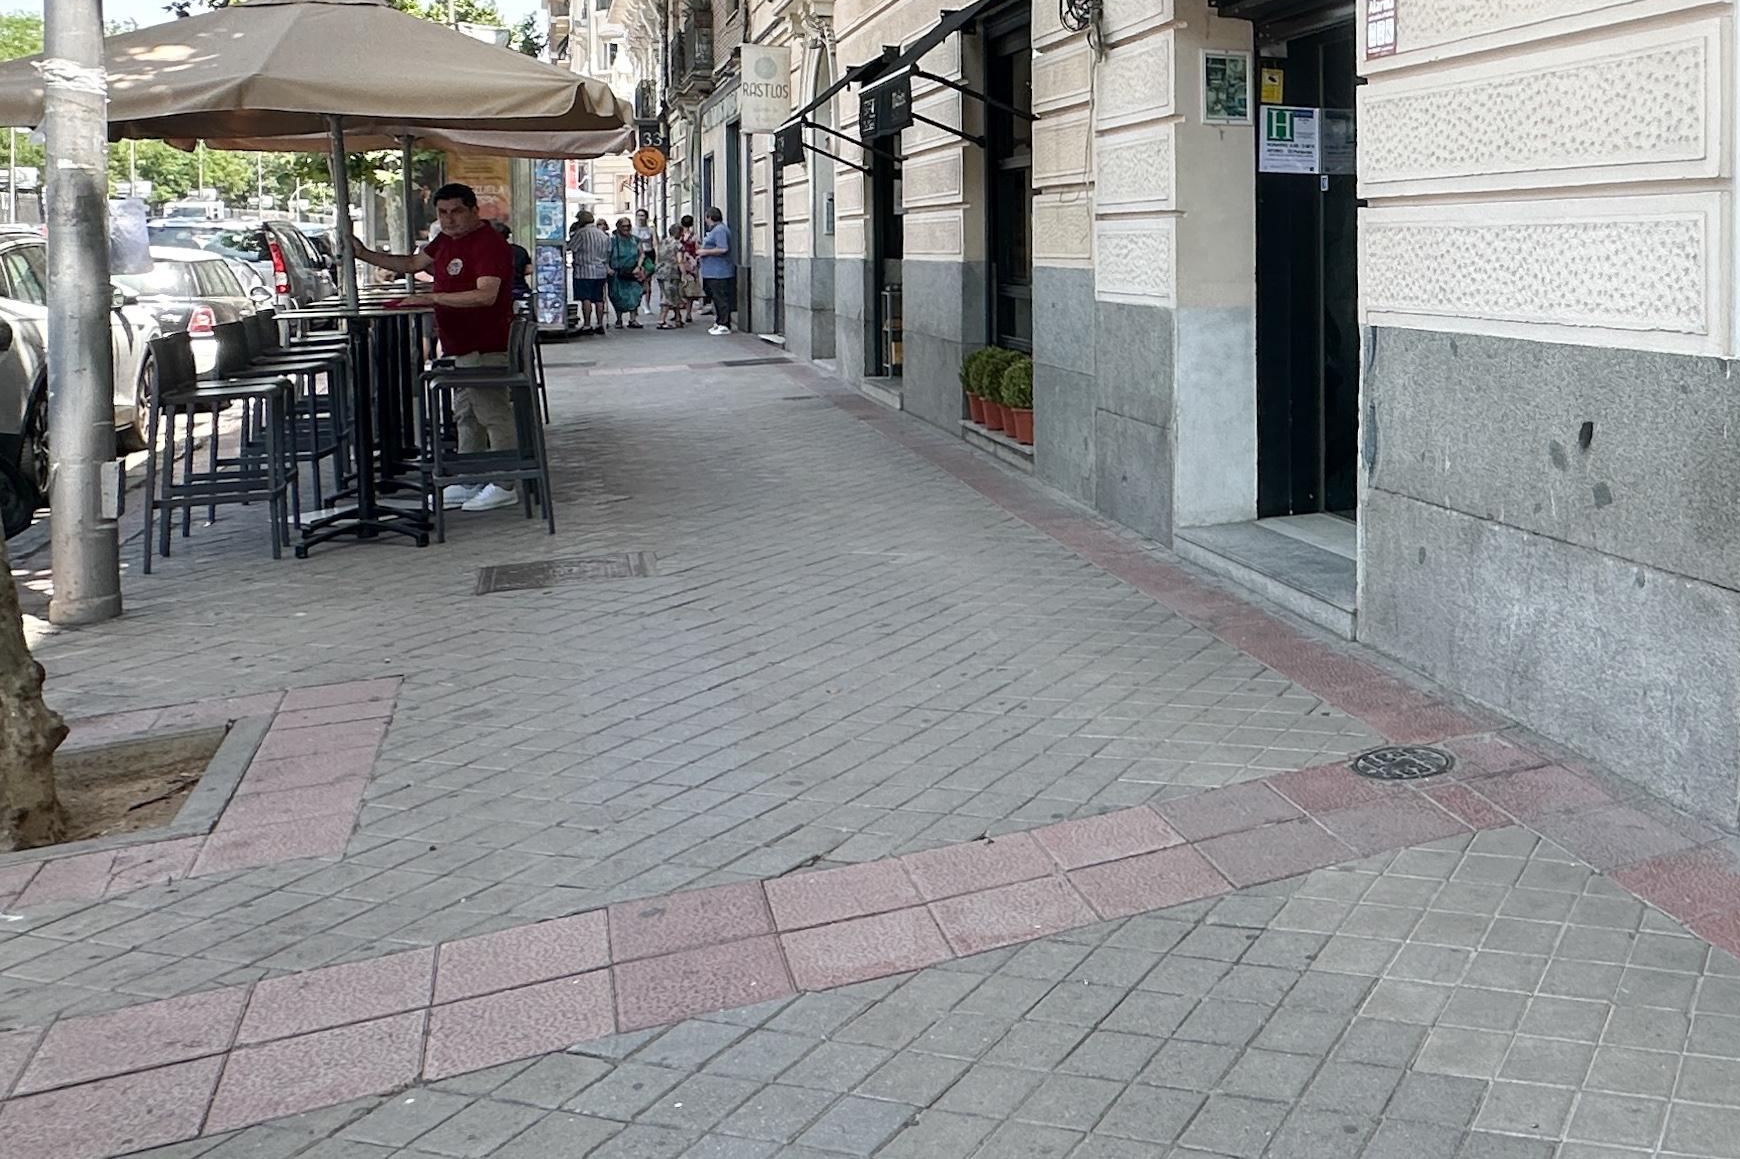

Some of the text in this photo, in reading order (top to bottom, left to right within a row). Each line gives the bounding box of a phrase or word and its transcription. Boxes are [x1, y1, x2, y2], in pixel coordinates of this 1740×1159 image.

[742, 81, 789, 99] RASTLOS
[1268, 109, 1294, 140] H
[643, 131, 663, 147] 33
